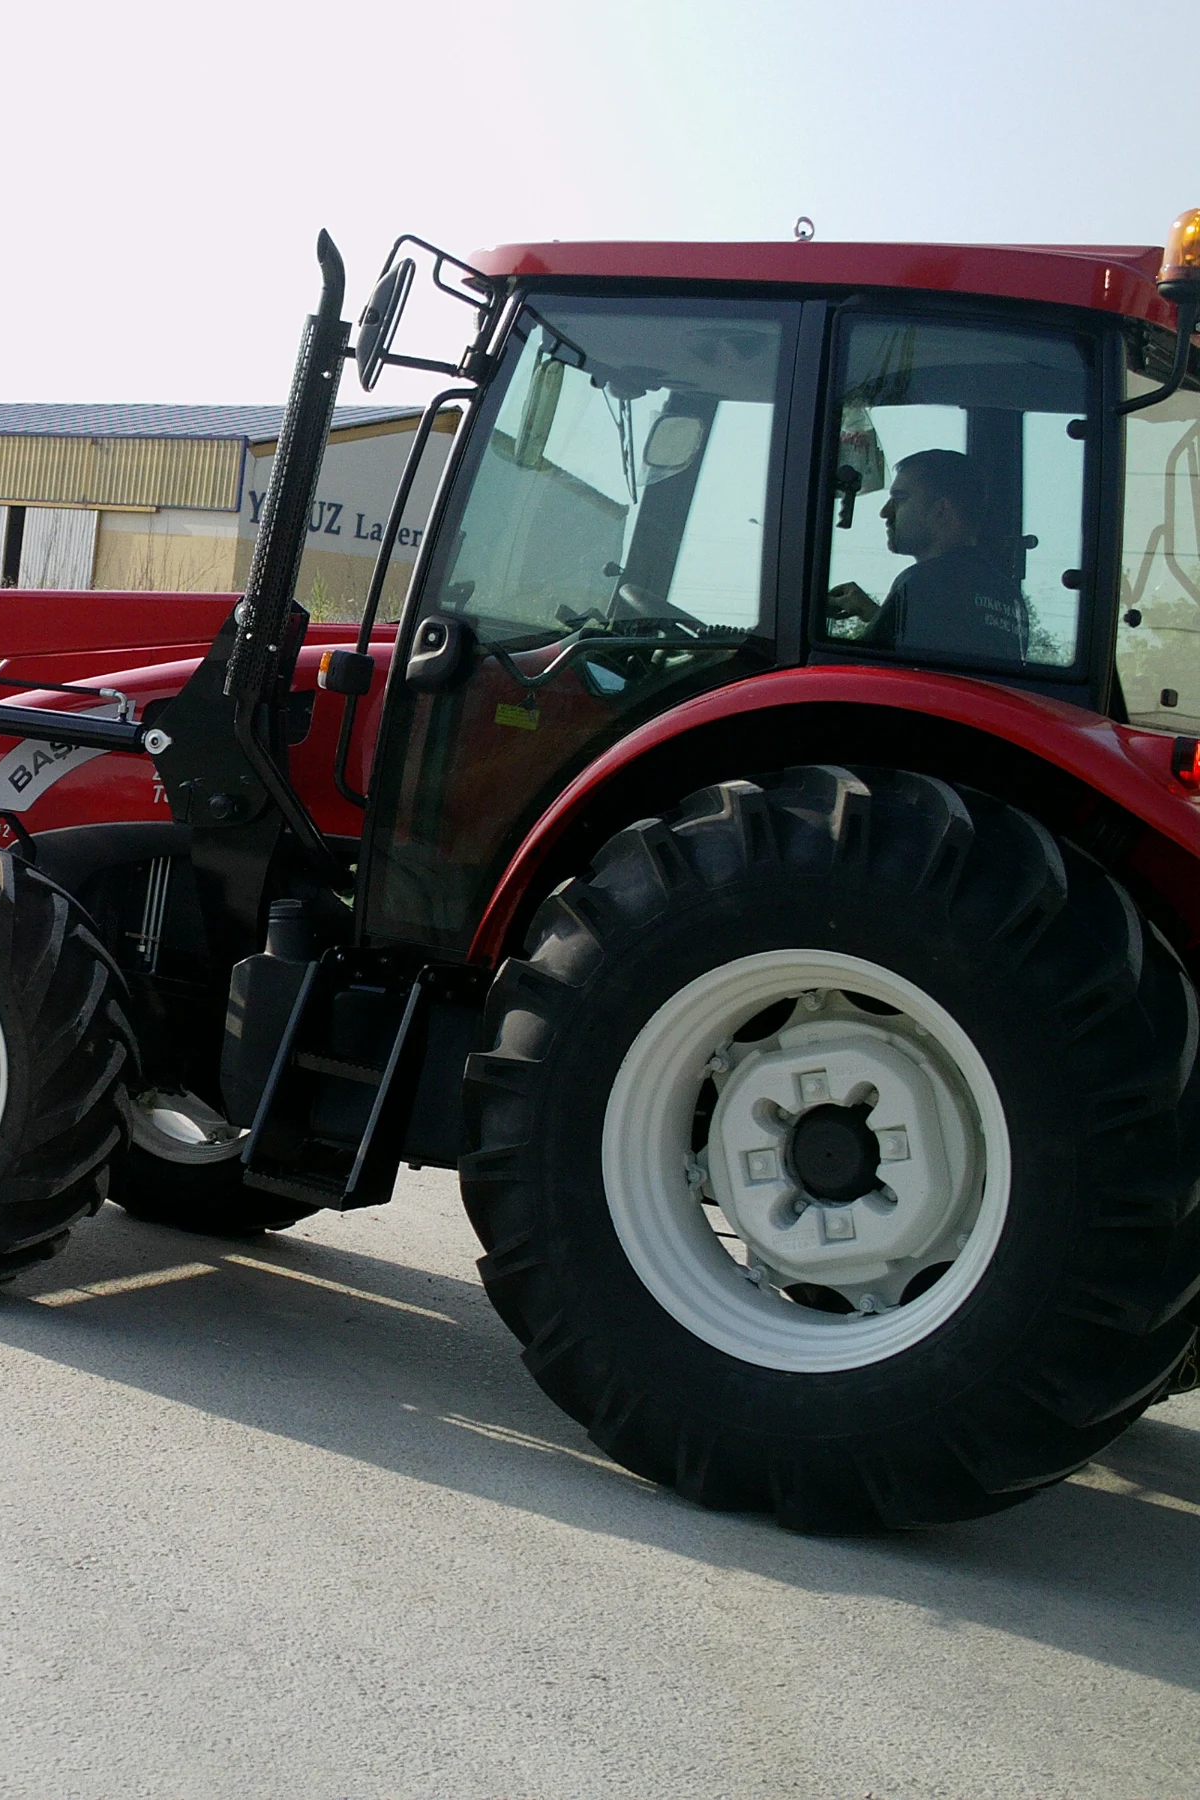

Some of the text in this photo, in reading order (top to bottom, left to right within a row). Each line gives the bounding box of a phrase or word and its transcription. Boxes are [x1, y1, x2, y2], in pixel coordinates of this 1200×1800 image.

[248, 490, 423, 547] YUZ Laer
[2, 823, 11, 838] 2
